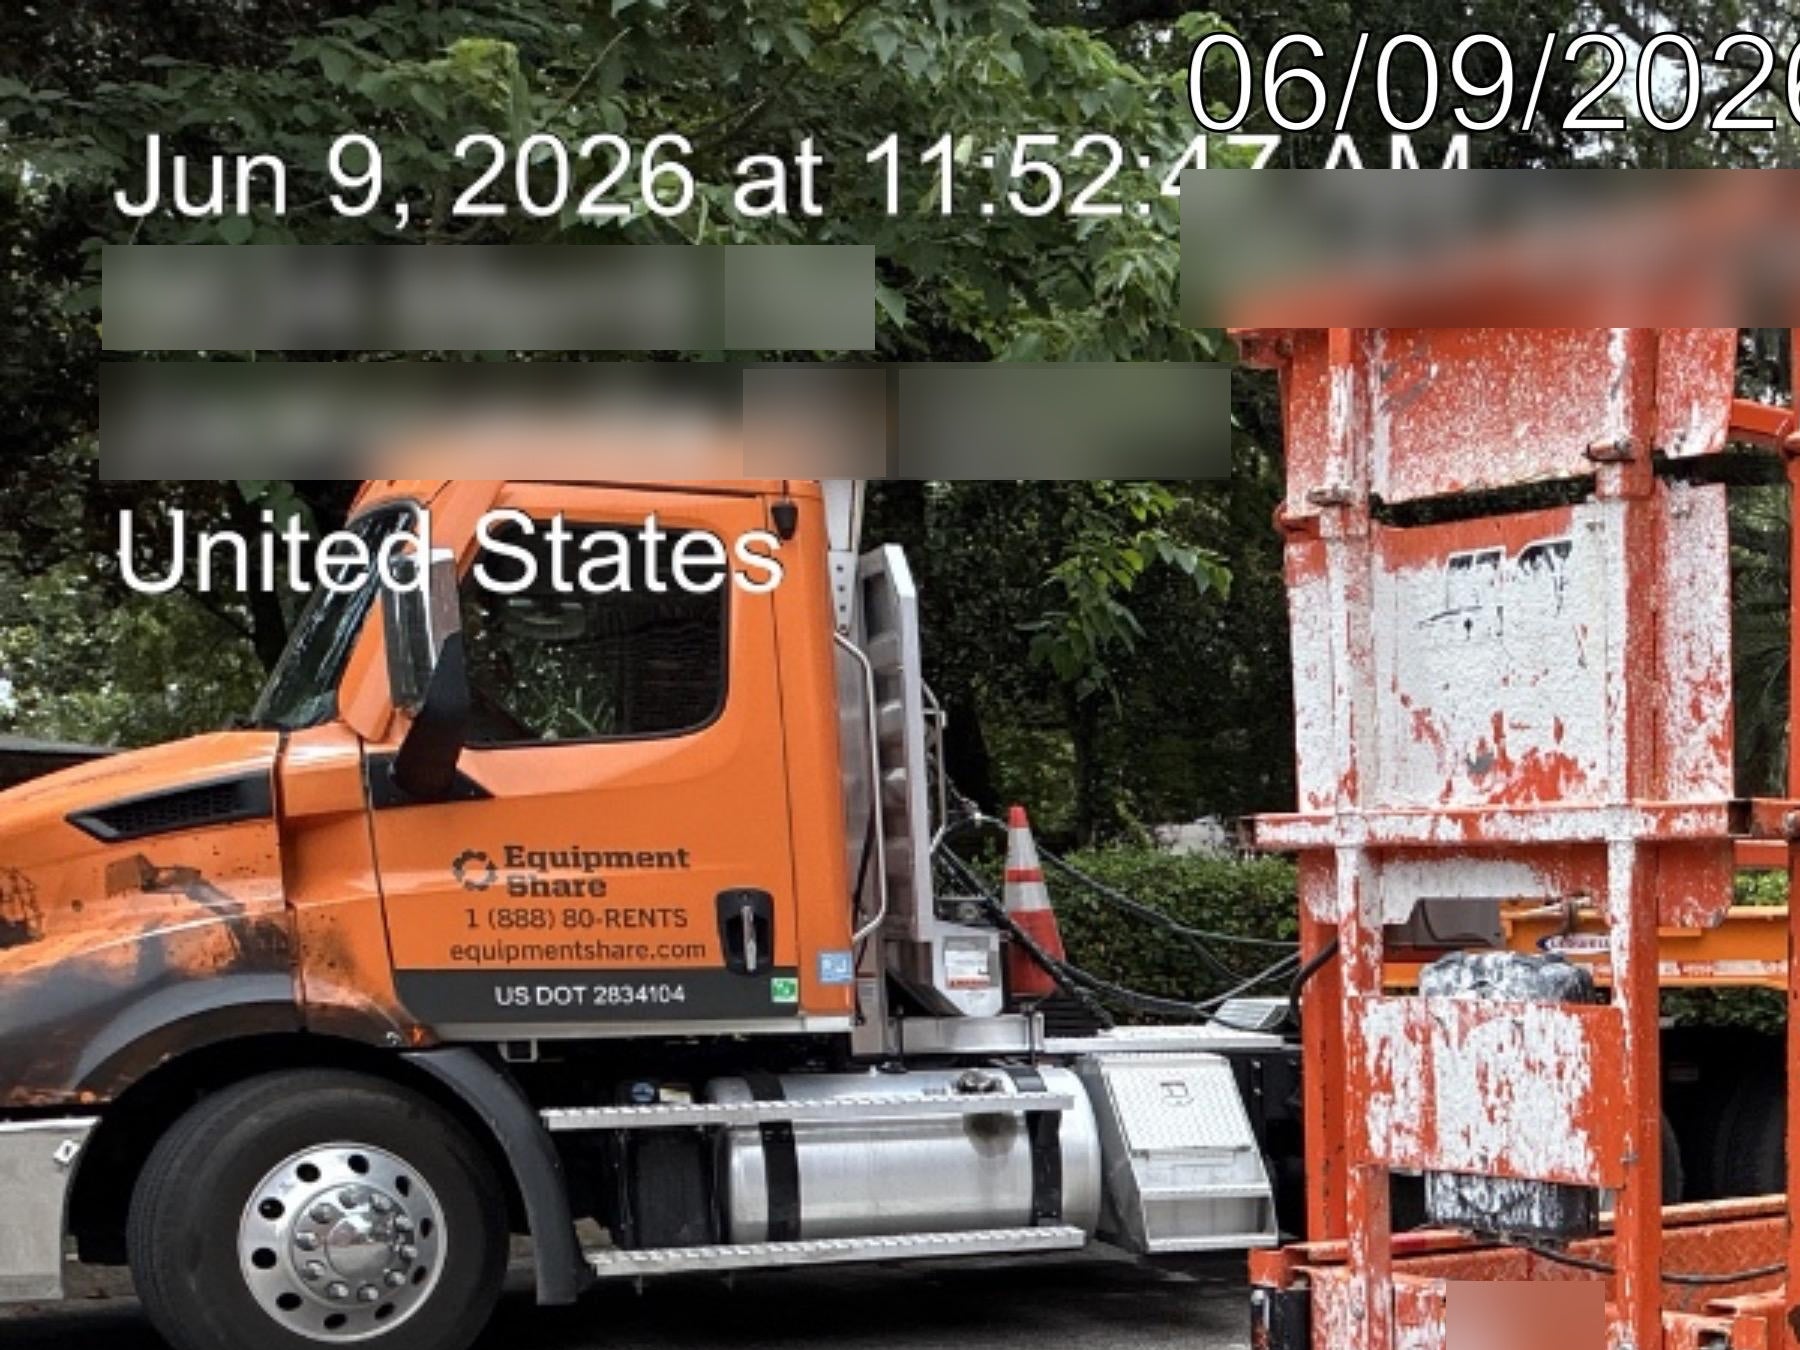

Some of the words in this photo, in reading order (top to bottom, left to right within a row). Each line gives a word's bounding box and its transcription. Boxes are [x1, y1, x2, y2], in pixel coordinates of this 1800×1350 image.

[503, 844, 690, 873] Equipment
[506, 874, 608, 898] Share
[465, 908, 478, 929] 1
[487, 907, 556, 932] (888)
[562, 907, 688, 929] 80-RENTS
[449, 939, 707, 966] equipmentshare.com
[494, 984, 530, 1006] US
[536, 985, 587, 1006] DOT
[593, 984, 686, 1005] 2834104
